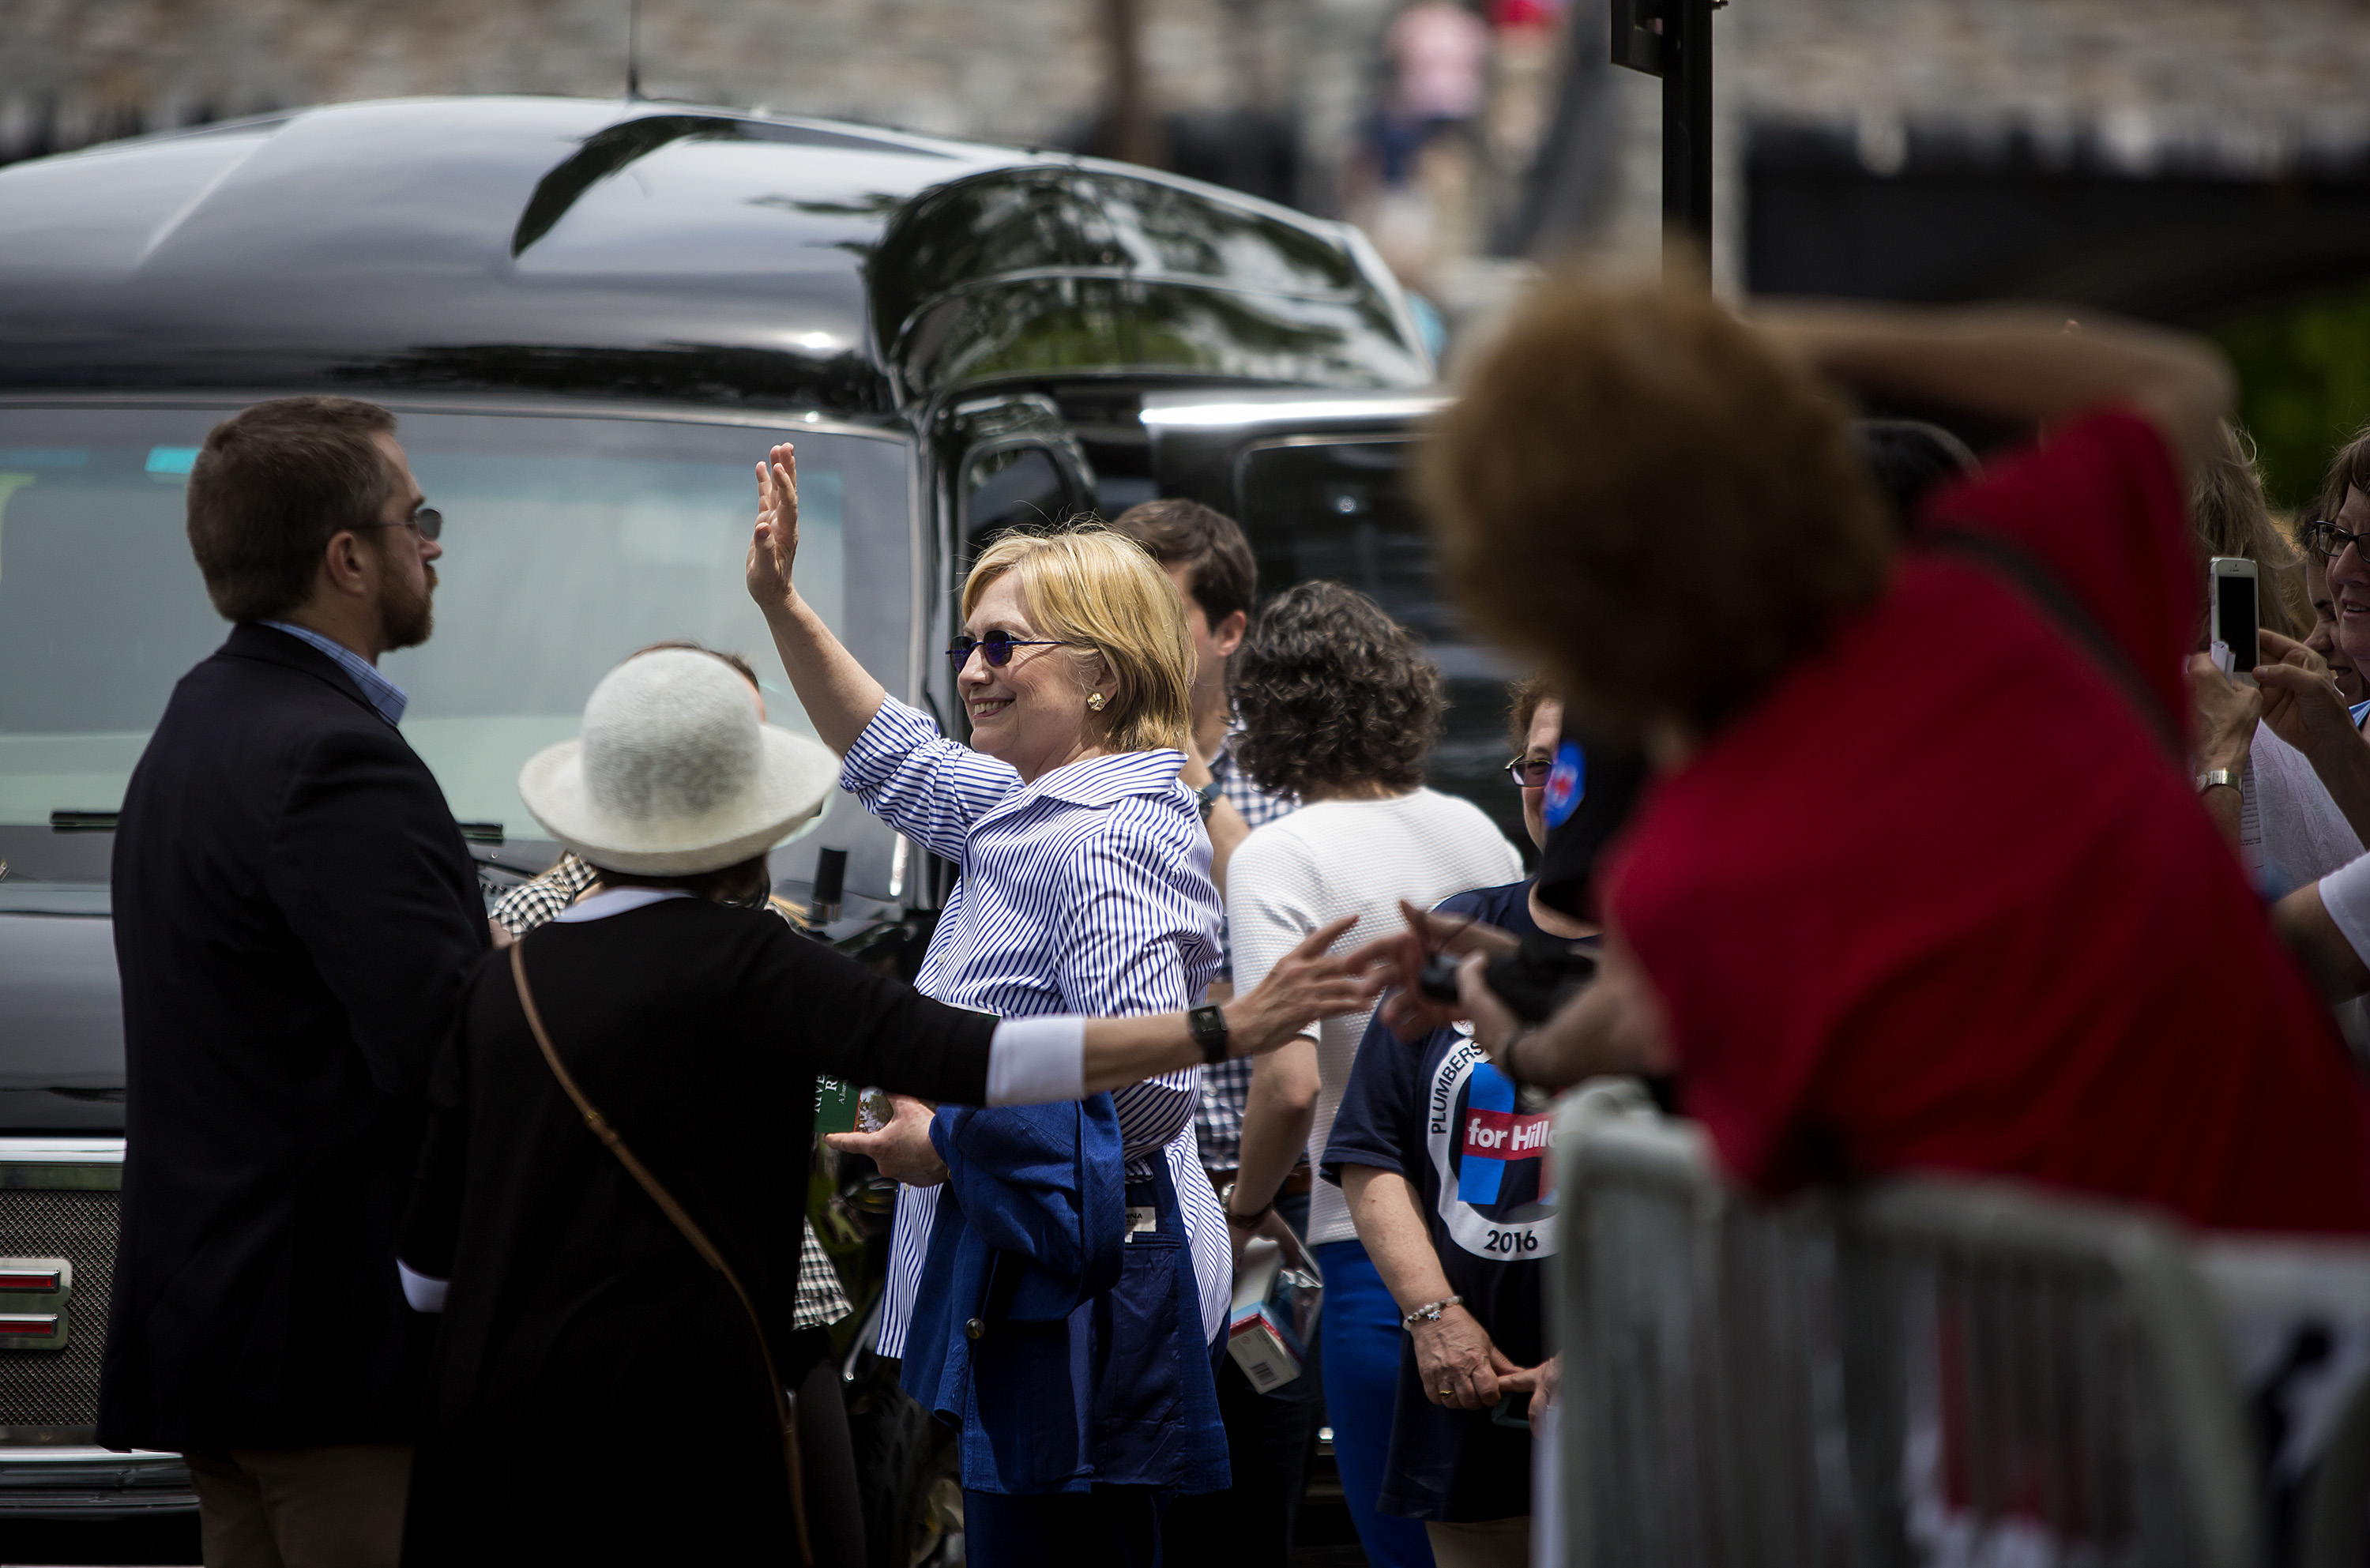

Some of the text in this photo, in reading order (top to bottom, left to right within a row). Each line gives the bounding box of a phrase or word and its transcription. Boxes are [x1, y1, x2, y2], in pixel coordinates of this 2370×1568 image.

[1431, 1040, 1485, 1134] PLUMBERS
[1468, 1118, 1507, 1149] for
[1484, 1230, 1538, 1254] 2016
